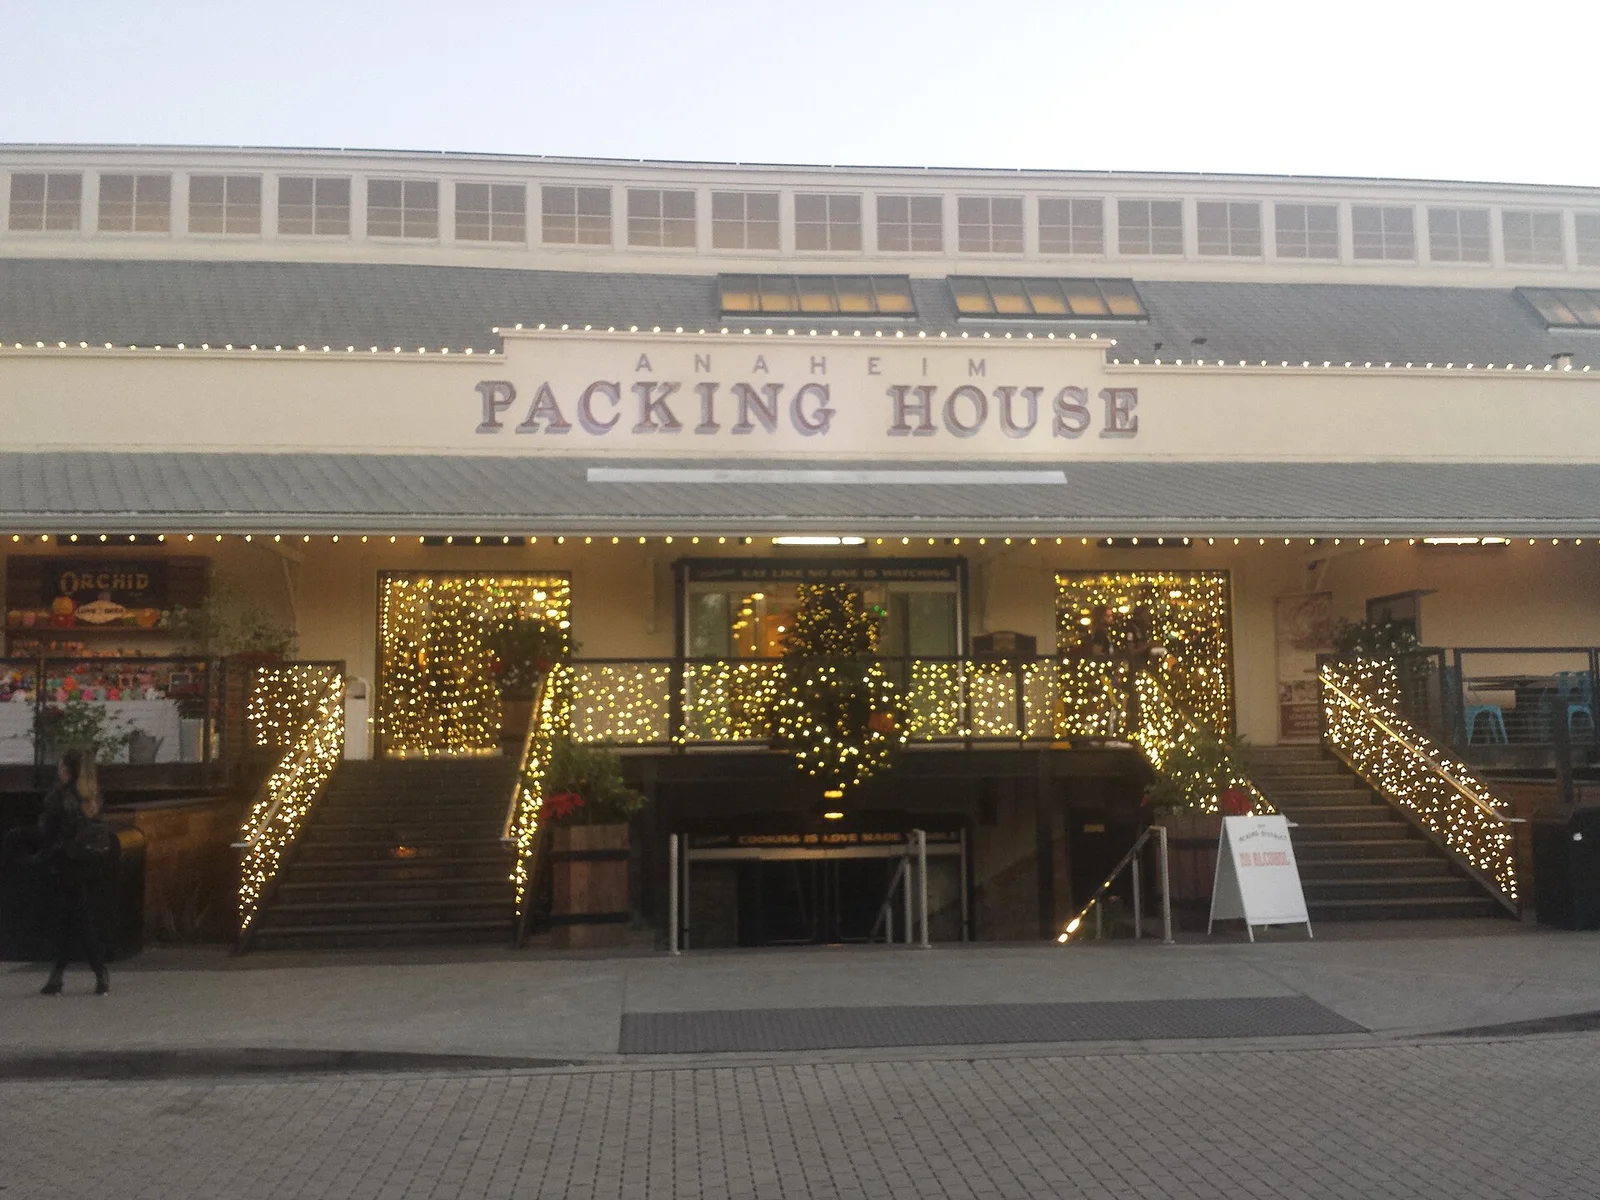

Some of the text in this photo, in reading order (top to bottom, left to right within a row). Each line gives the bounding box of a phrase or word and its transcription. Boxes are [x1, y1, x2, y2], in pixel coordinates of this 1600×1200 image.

[634, 353, 988, 377] ANAHEIM
[475, 379, 1140, 440] PACKING HOUSE
[60, 570, 150, 595] ORCHID
[772, 568, 804, 578] LIKE
[808, 568, 827, 578] NO
[882, 568, 951, 578] WATCHING
[737, 834, 800, 845] COOKING
[803, 833, 819, 844] IS
[823, 833, 857, 844] LOVE
[862, 832, 902, 842] MADE
